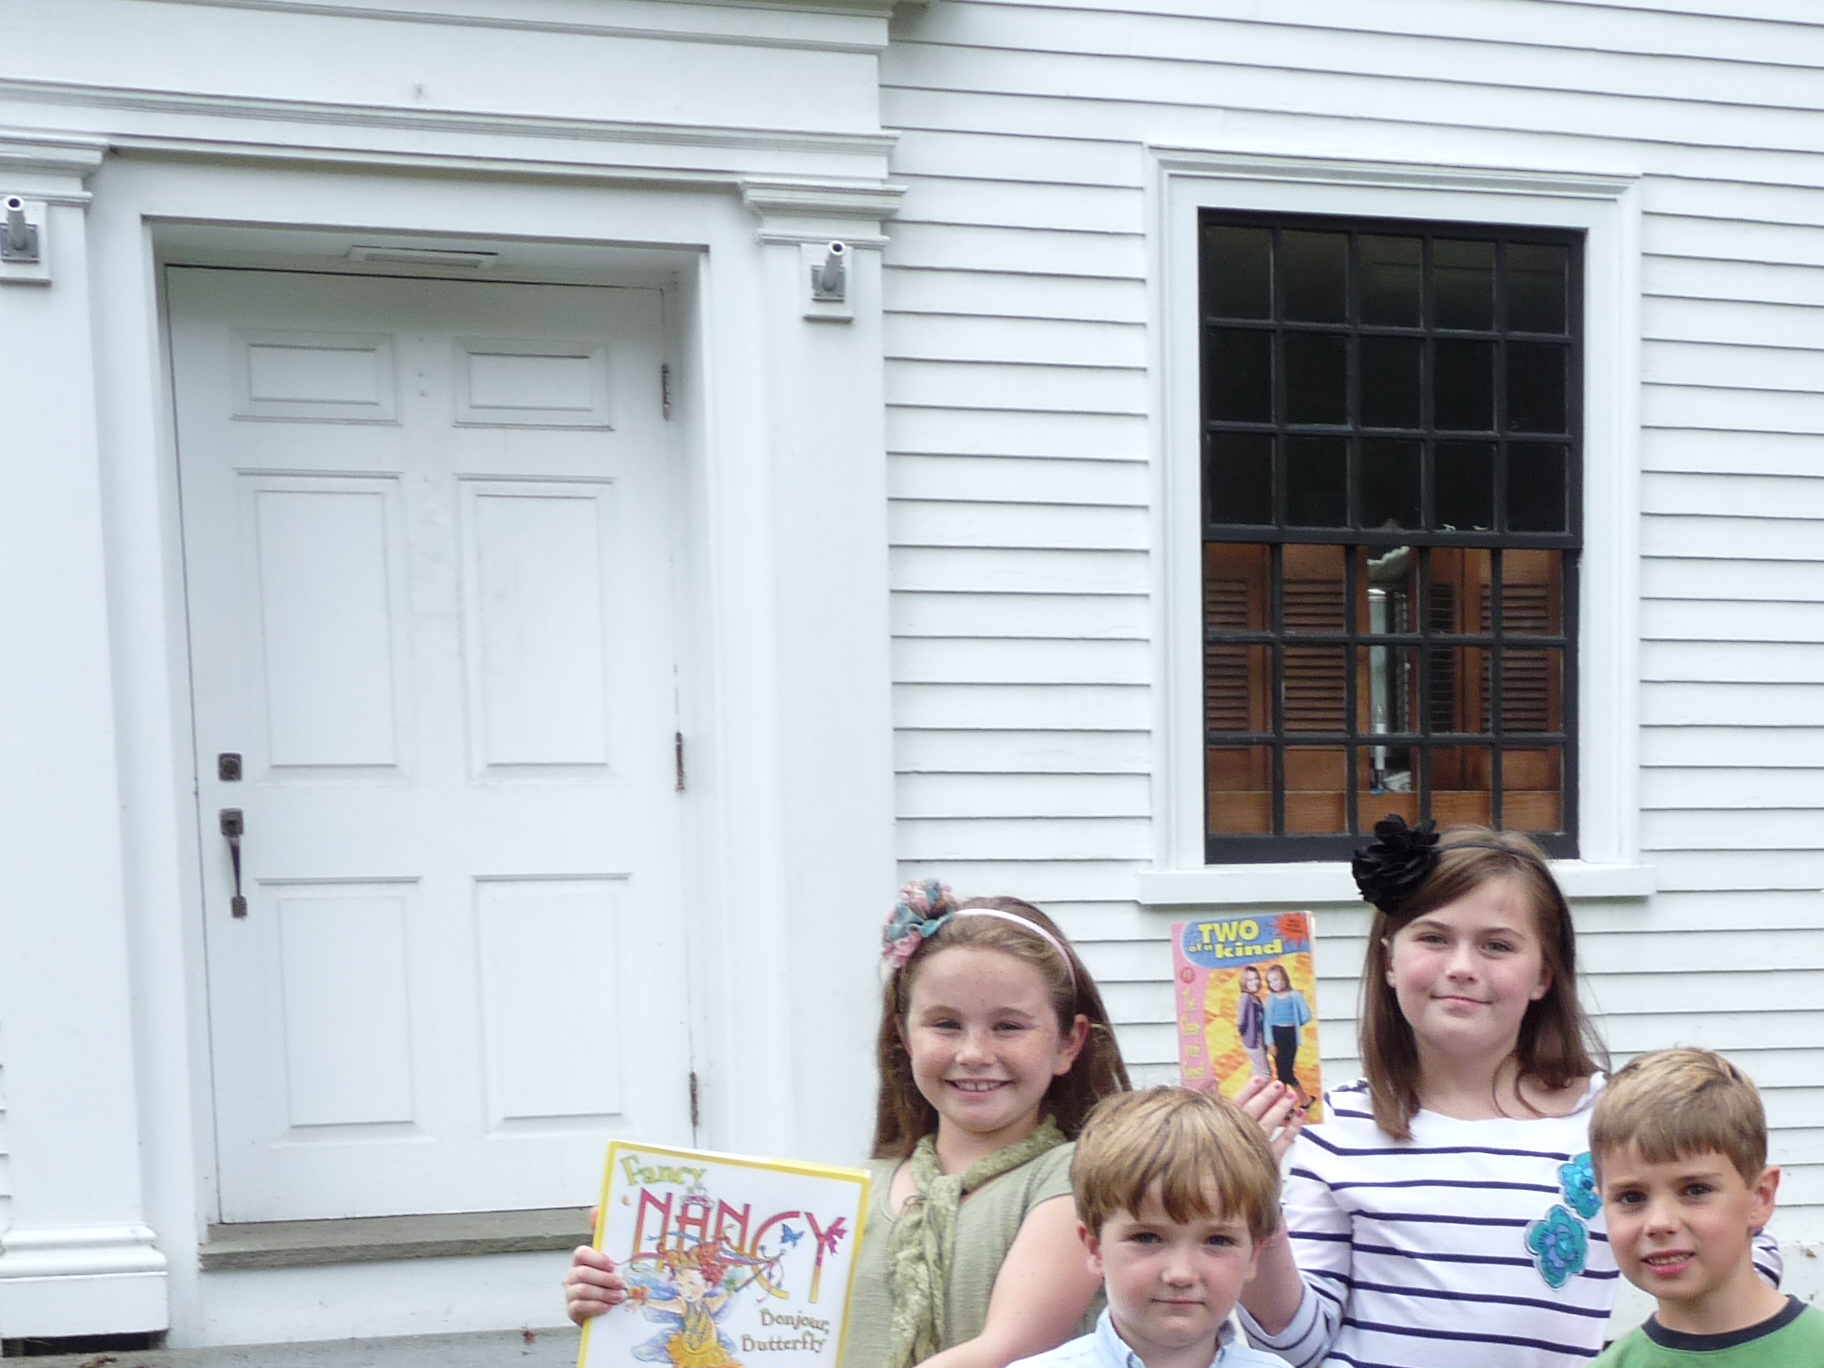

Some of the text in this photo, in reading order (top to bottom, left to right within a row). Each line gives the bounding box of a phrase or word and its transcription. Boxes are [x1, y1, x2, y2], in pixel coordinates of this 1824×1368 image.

[1197, 918, 1260, 944] TWO
[1215, 939, 1283, 959] kind
[620, 1154, 707, 1188] Fancy
[631, 1187, 848, 1304] NANCY
